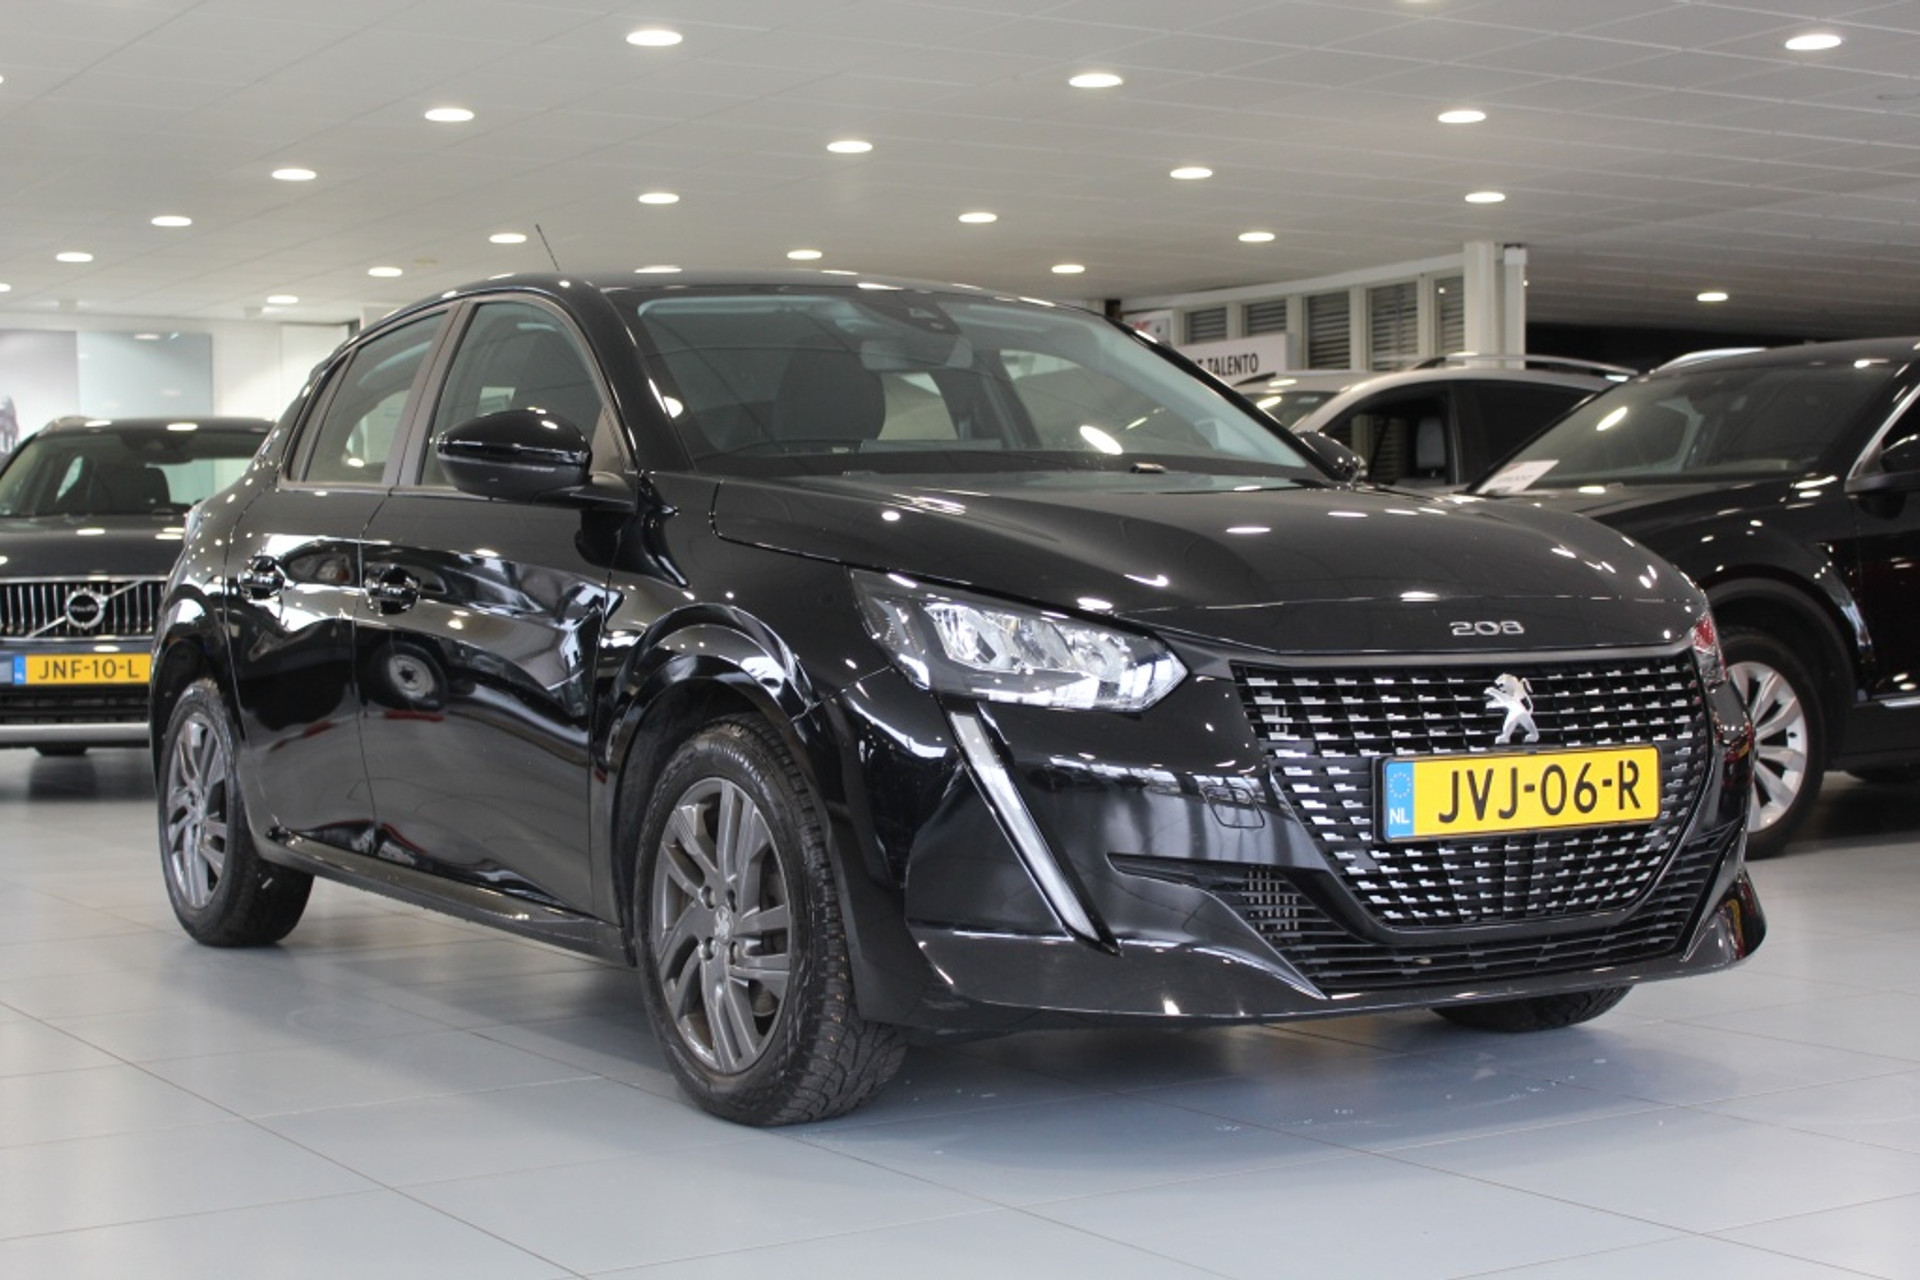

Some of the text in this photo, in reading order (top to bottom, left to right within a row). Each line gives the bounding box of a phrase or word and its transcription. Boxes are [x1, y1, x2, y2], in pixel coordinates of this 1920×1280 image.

[1207, 353, 1258, 375] TALENTO
[1450, 621, 1525, 636] 208
[39, 659, 140, 679] JNF-10-L
[1438, 760, 1641, 824] JVJ-06-R
[1389, 808, 1410, 824] NL
